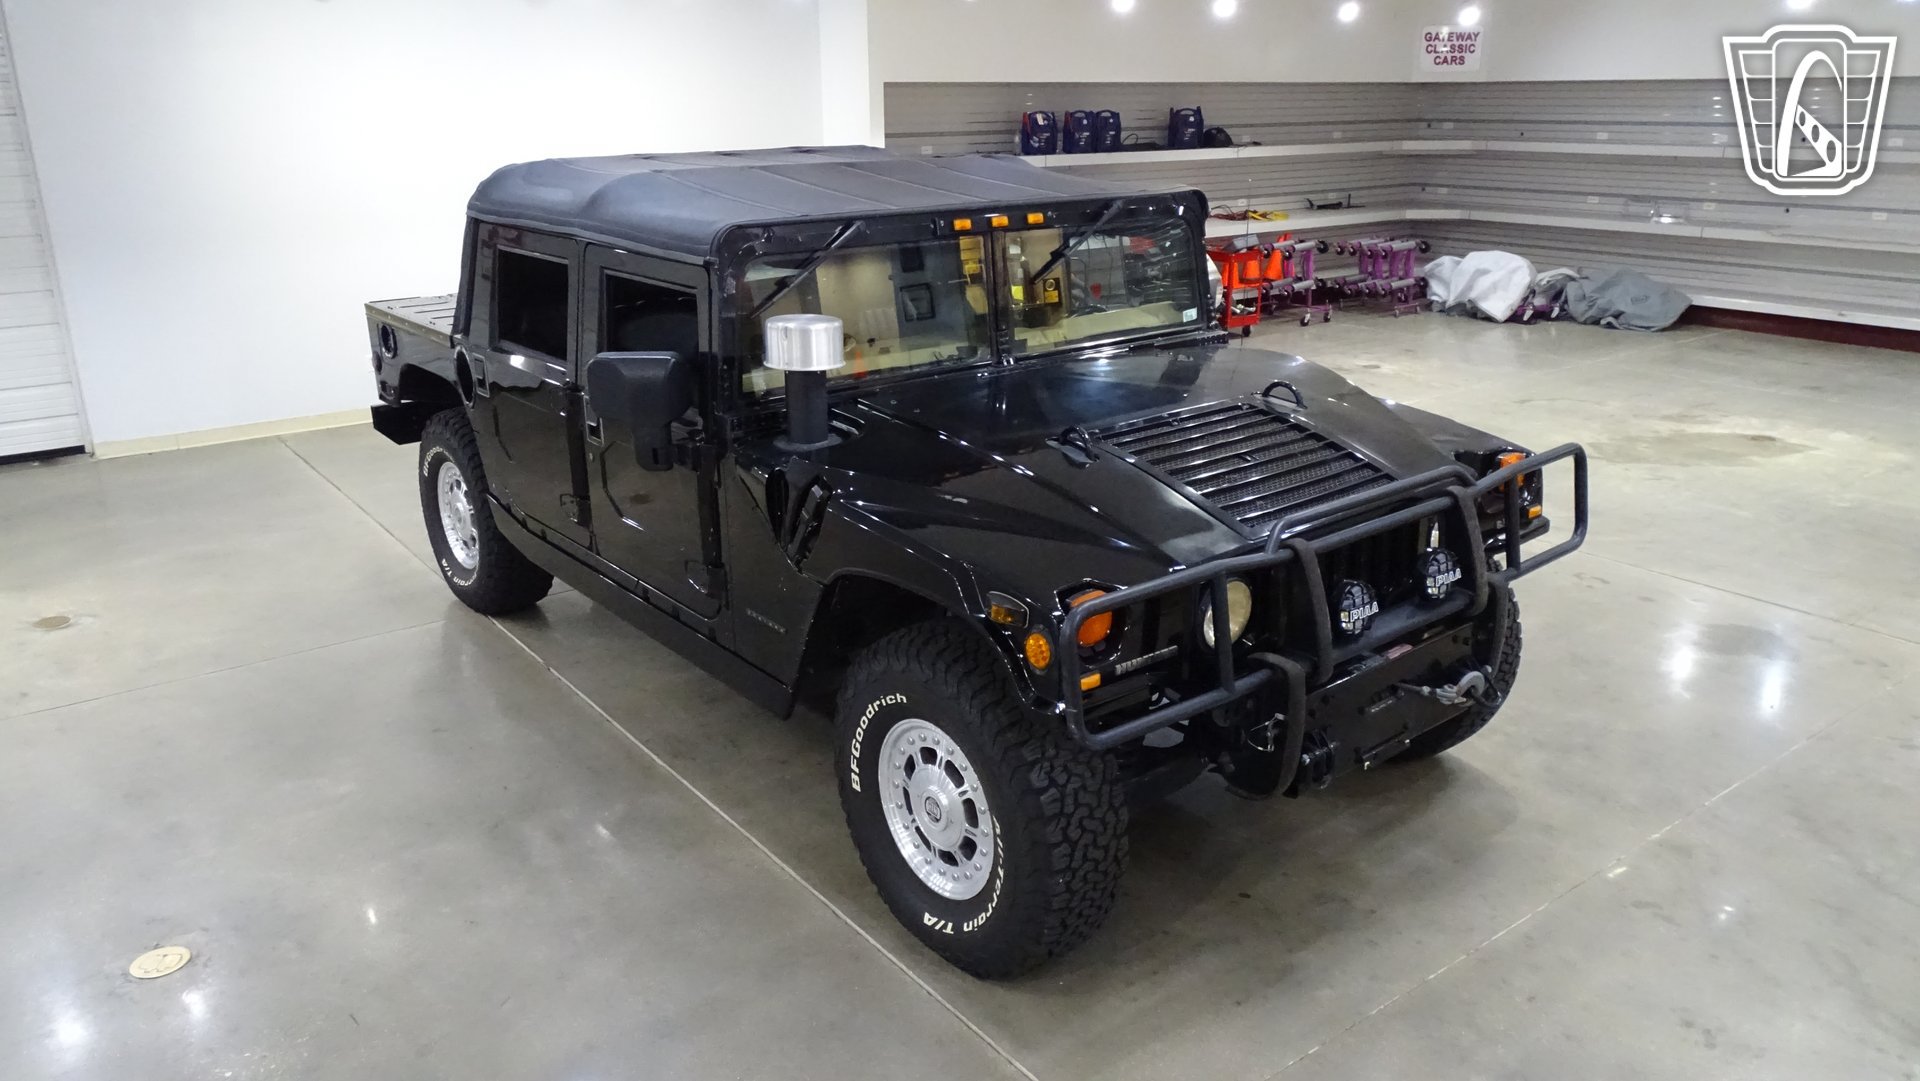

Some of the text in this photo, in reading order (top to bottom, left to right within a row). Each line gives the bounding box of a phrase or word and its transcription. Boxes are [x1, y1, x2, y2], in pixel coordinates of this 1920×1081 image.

[1426, 44, 1476, 54] CLASSIC
[1434, 56, 1465, 65] CARS
[423, 446, 455, 477] BFGood
[442, 558, 452, 577] T/A
[1436, 568, 1461, 587] PIAA
[1350, 601, 1379, 622] PIAA
[850, 693, 908, 793] BFGoodrich
[923, 911, 954, 935] T/A
